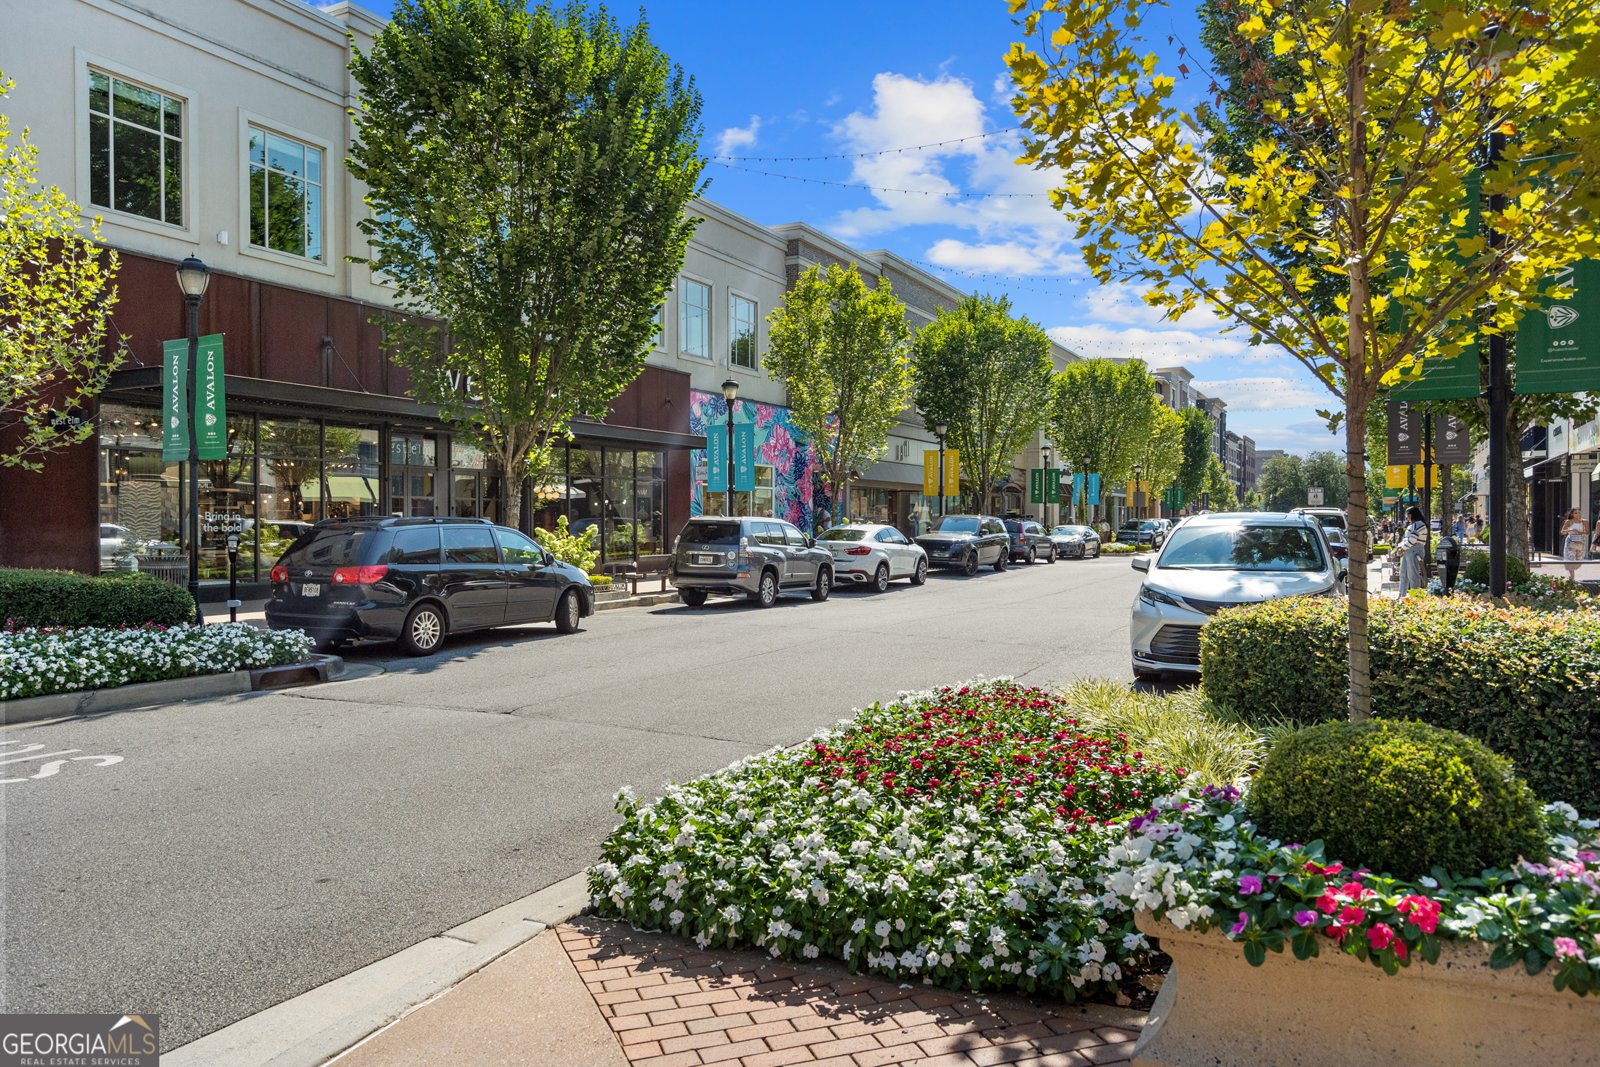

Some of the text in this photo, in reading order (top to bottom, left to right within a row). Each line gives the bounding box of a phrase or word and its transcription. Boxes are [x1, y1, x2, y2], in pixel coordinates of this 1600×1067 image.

[206, 350, 215, 410] AVALON
[1399, 400, 1409, 431] AVAL
[203, 523, 242, 532] the bold
[205, 511, 241, 523] Bring in
